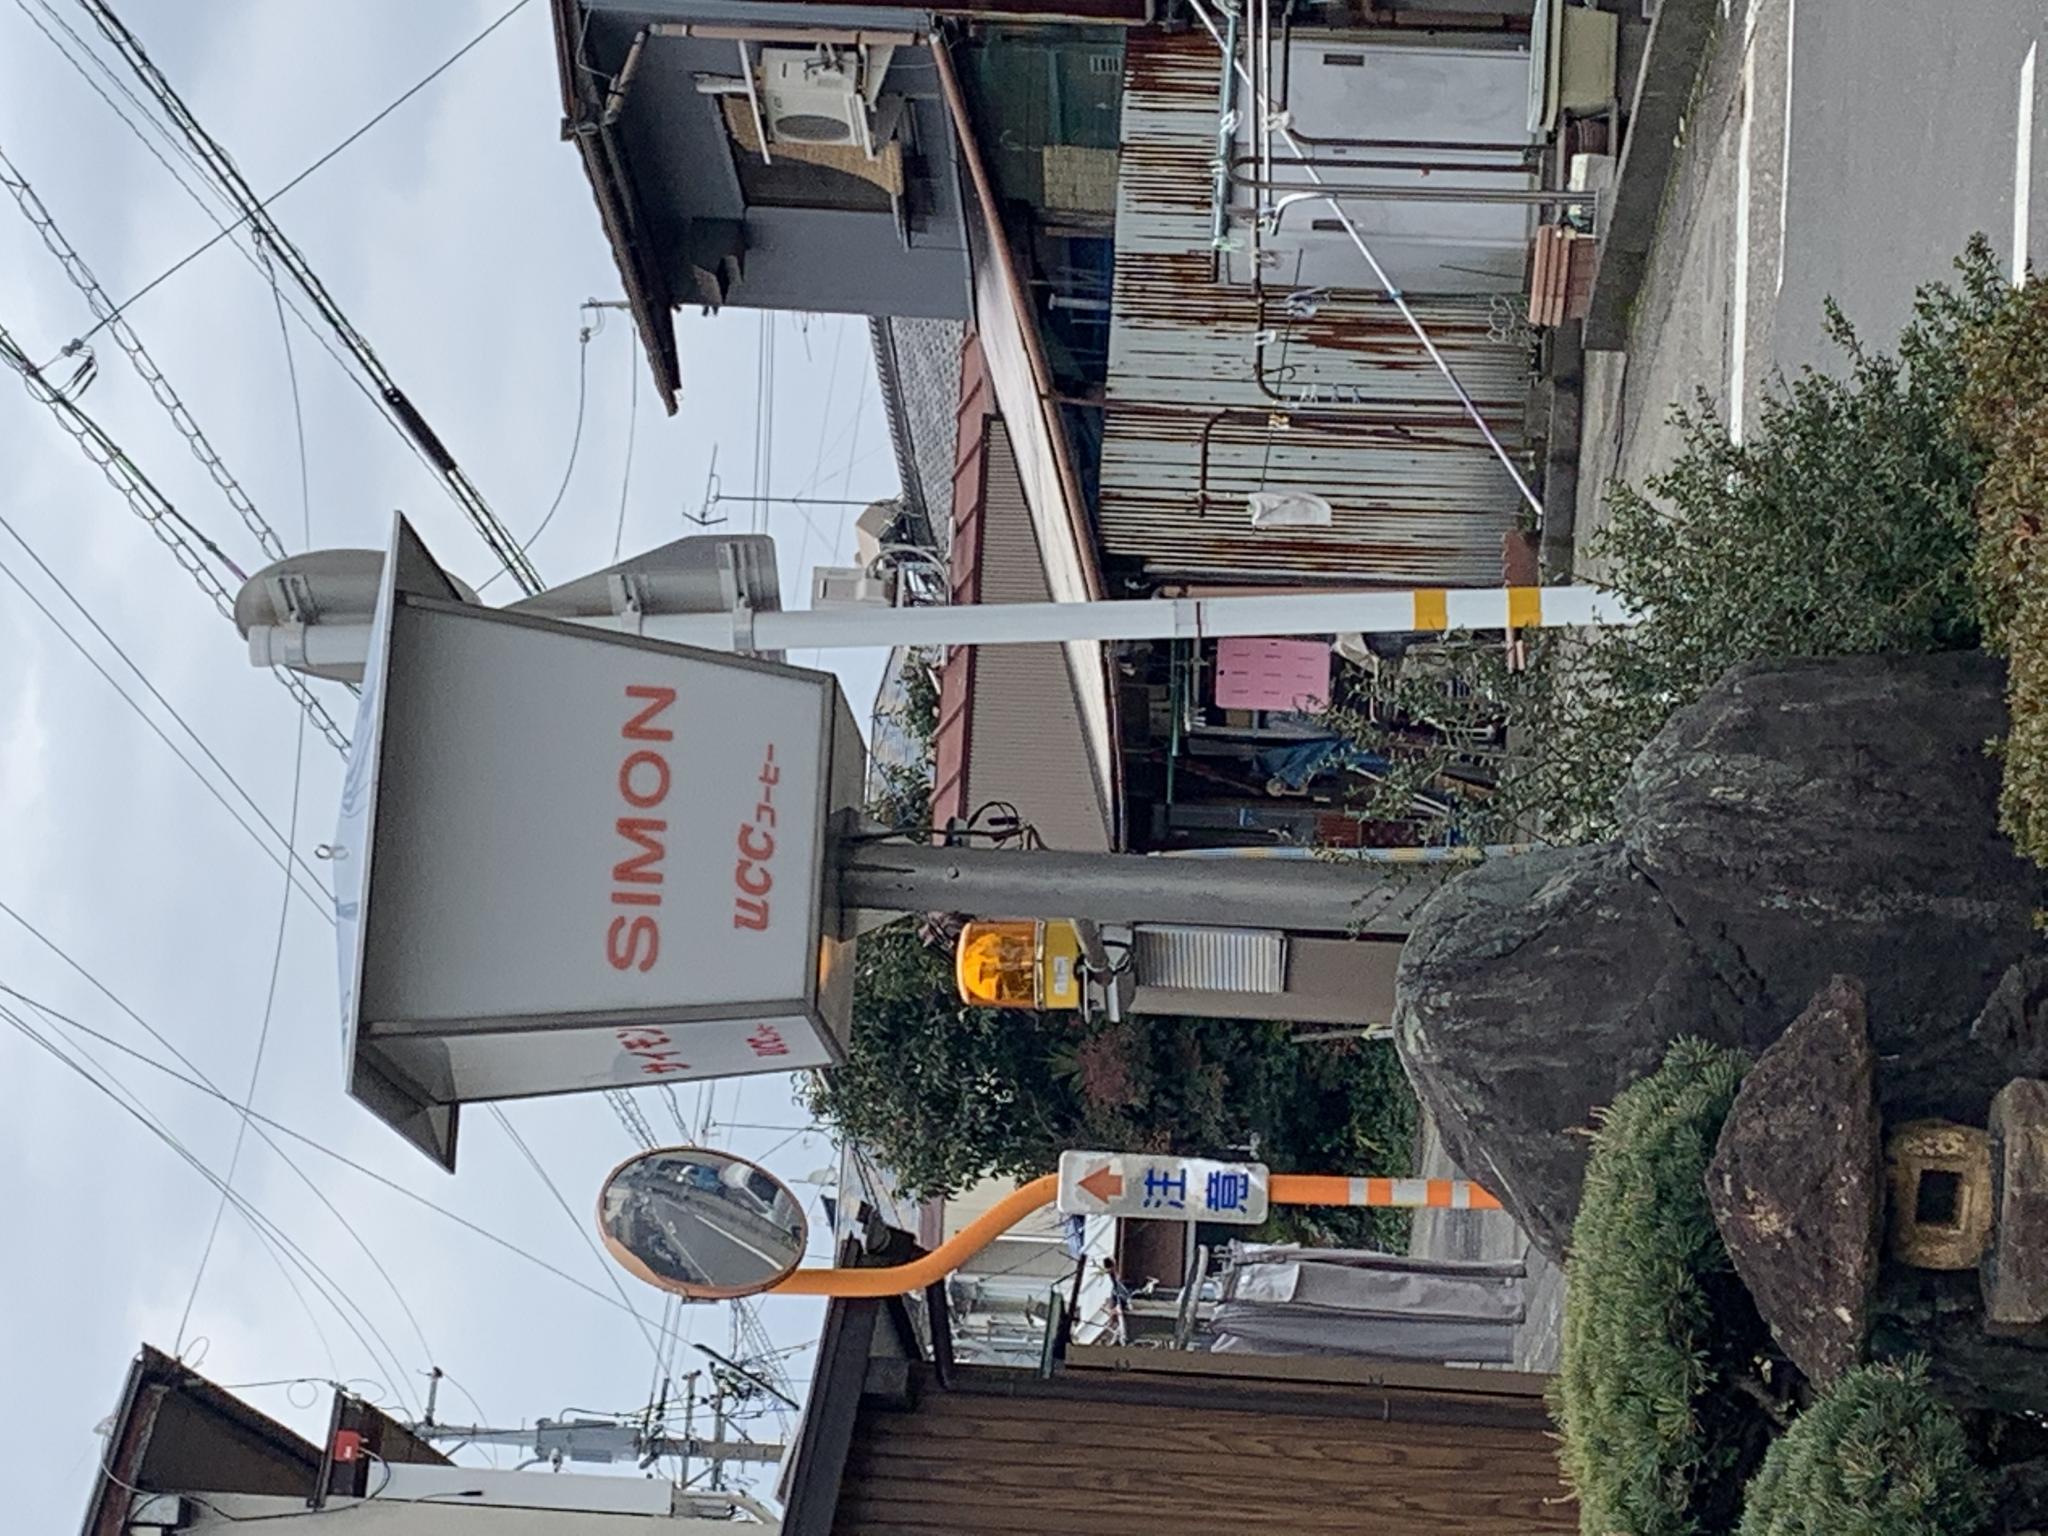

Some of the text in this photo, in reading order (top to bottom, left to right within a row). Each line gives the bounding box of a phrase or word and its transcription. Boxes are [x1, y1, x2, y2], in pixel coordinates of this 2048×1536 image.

[606, 684, 678, 973] SIMON
[615, 1027, 691, 1074] サイモン
[1144, 1168, 1249, 1214] 注意
